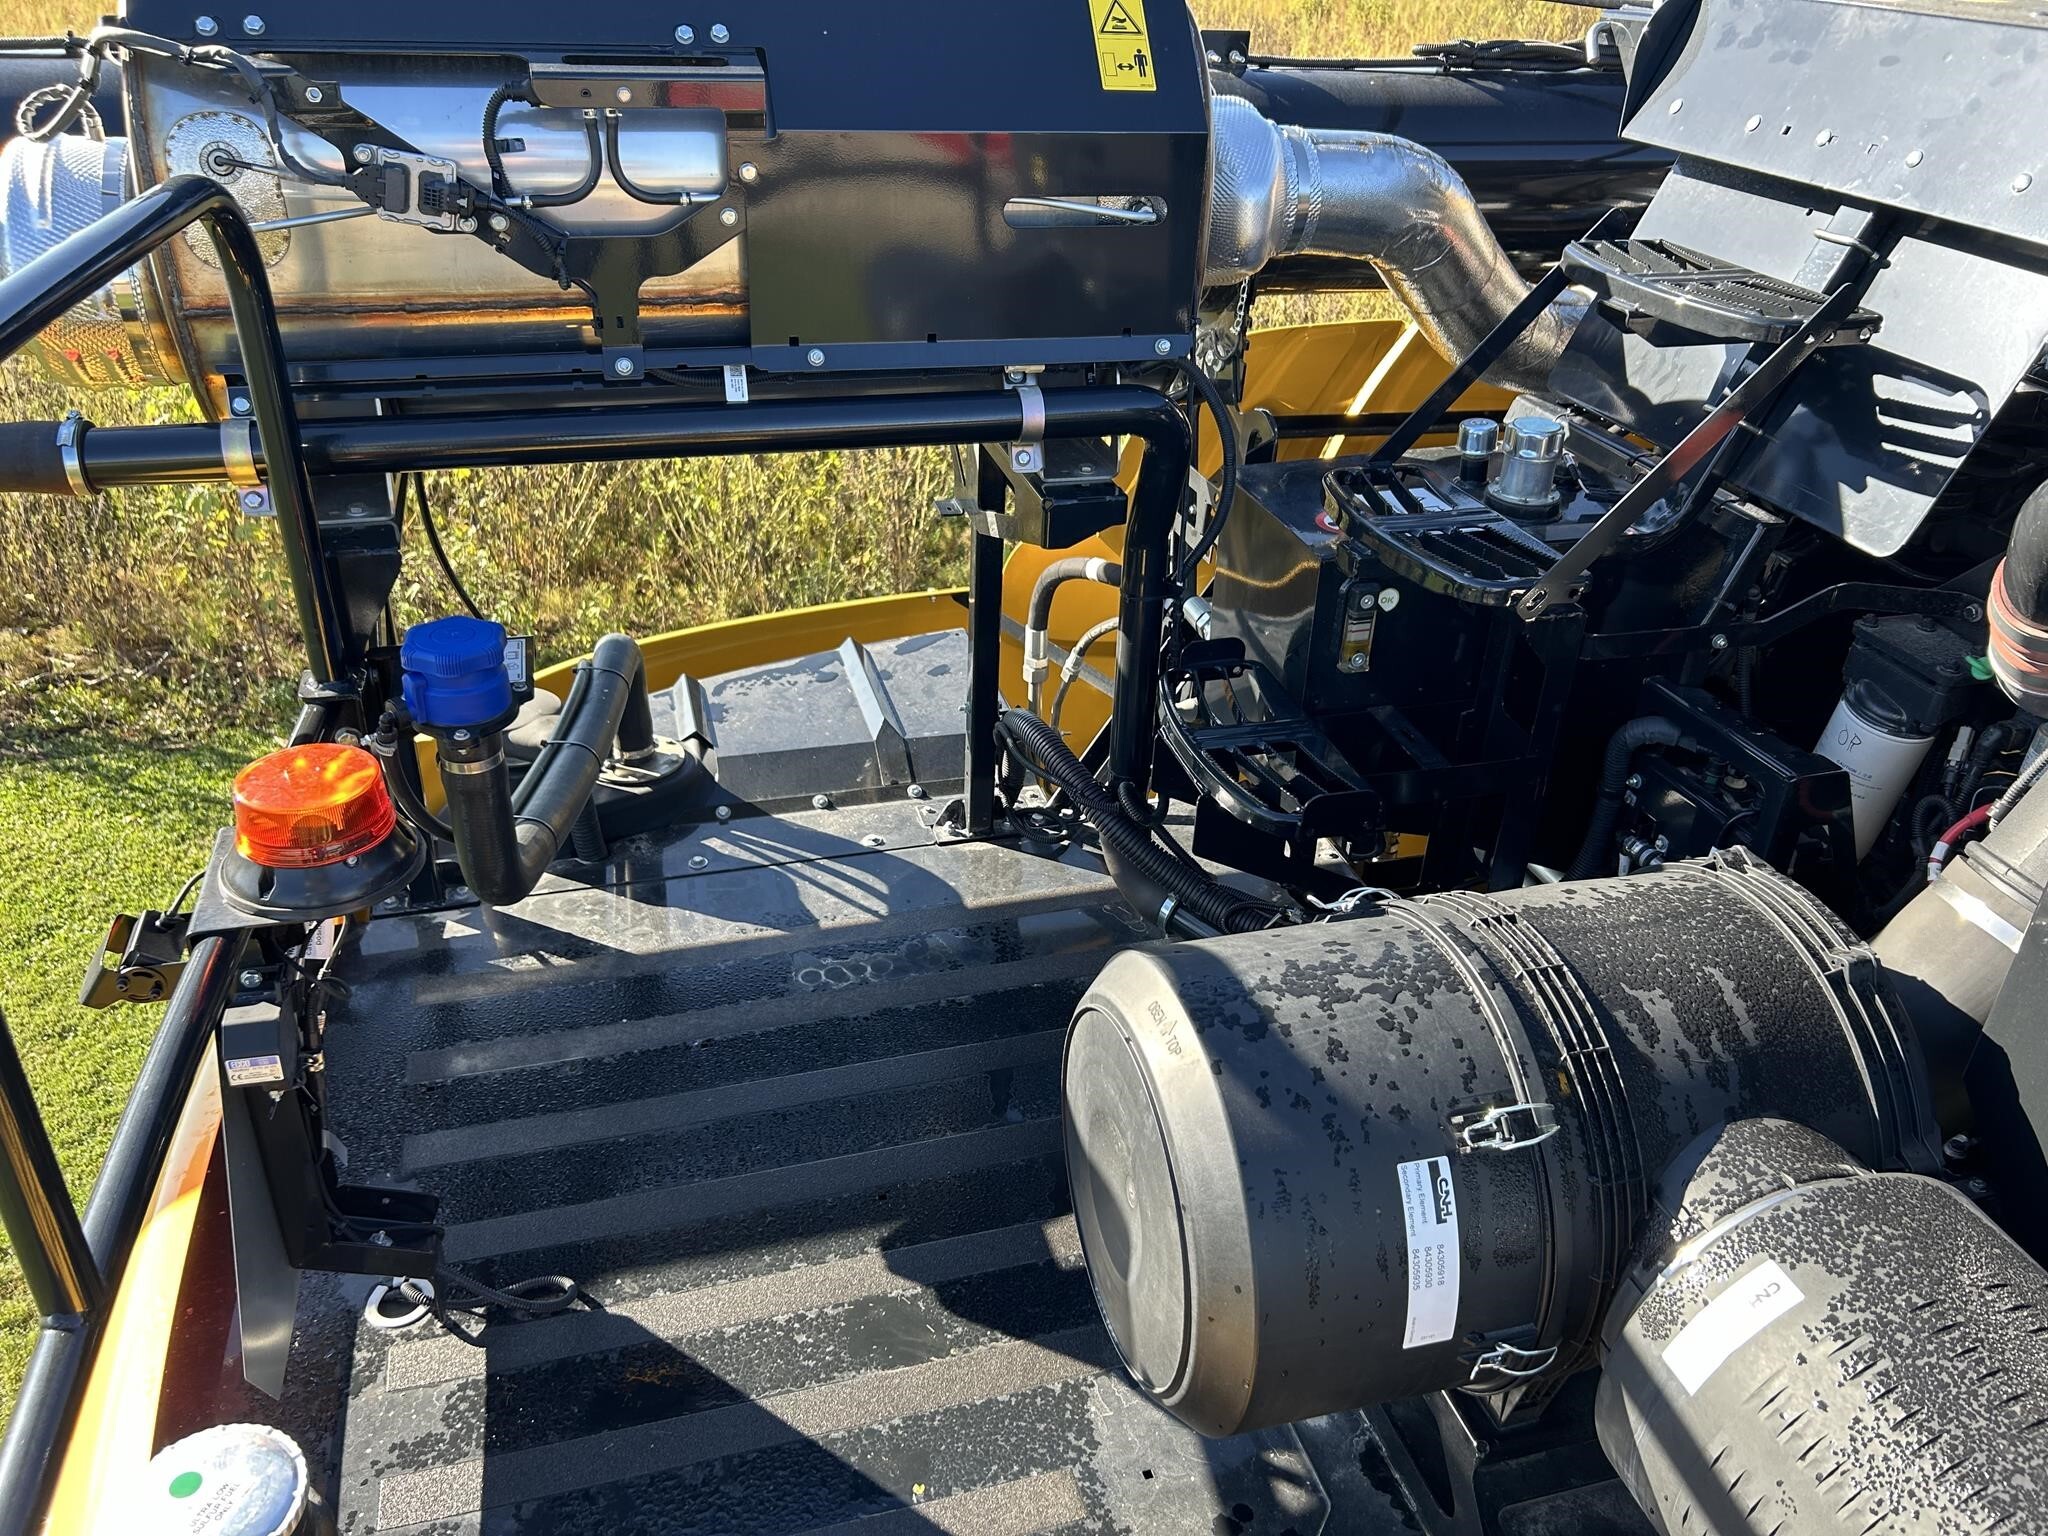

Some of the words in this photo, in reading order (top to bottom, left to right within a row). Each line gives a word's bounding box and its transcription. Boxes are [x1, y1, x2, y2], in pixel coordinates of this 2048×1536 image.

[1380, 596, 1395, 604] OK
[1165, 1034, 1182, 1056] TOP
[1414, 1162, 1423, 1191] Primary
[1401, 1165, 1411, 1205] Secondary
[1407, 1206, 1416, 1237] Element
[1418, 1193, 1428, 1224] Element
[1438, 1177, 1453, 1217] CNH
[1412, 1248, 1421, 1291] 84305935
[1424, 1246, 1433, 1289] 84305930
[1436, 1243, 1446, 1286] 84305918
[189, 1502, 213, 1527] ULTRA
[212, 1483, 229, 1501] LOW
[220, 1483, 240, 1502] FUEL
[214, 1500, 233, 1521] ONLY
